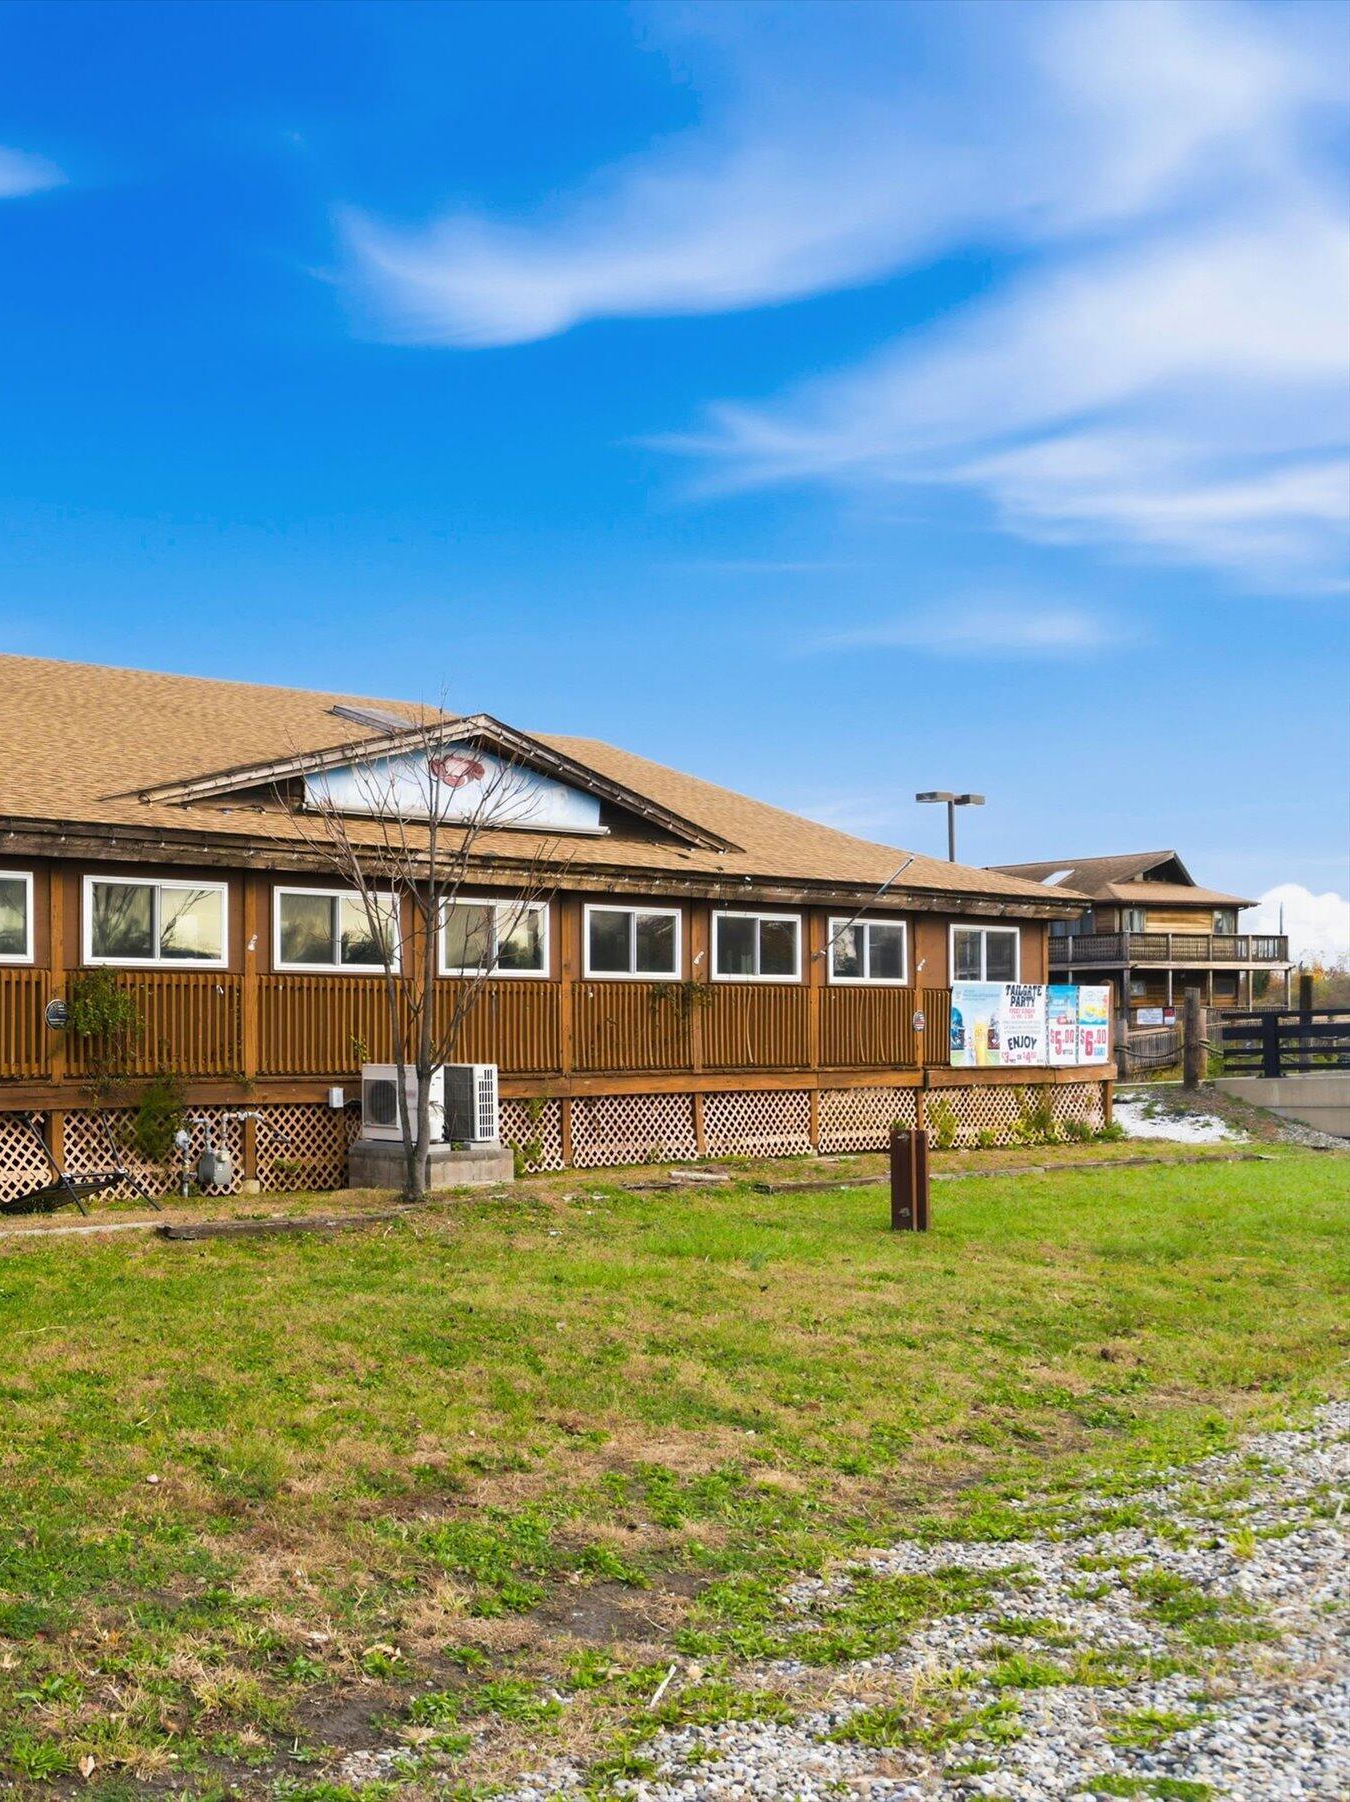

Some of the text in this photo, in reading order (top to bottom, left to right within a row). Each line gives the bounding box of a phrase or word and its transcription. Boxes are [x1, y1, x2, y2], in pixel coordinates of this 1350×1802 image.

[1005, 984, 1043, 996] TAILGATE
[1010, 996, 1036, 1007] PARTY
[1007, 1035, 1037, 1050] ENJOY
[1050, 1029, 1075, 1056] $5.00
[1080, 1028, 1107, 1056] $6.00
